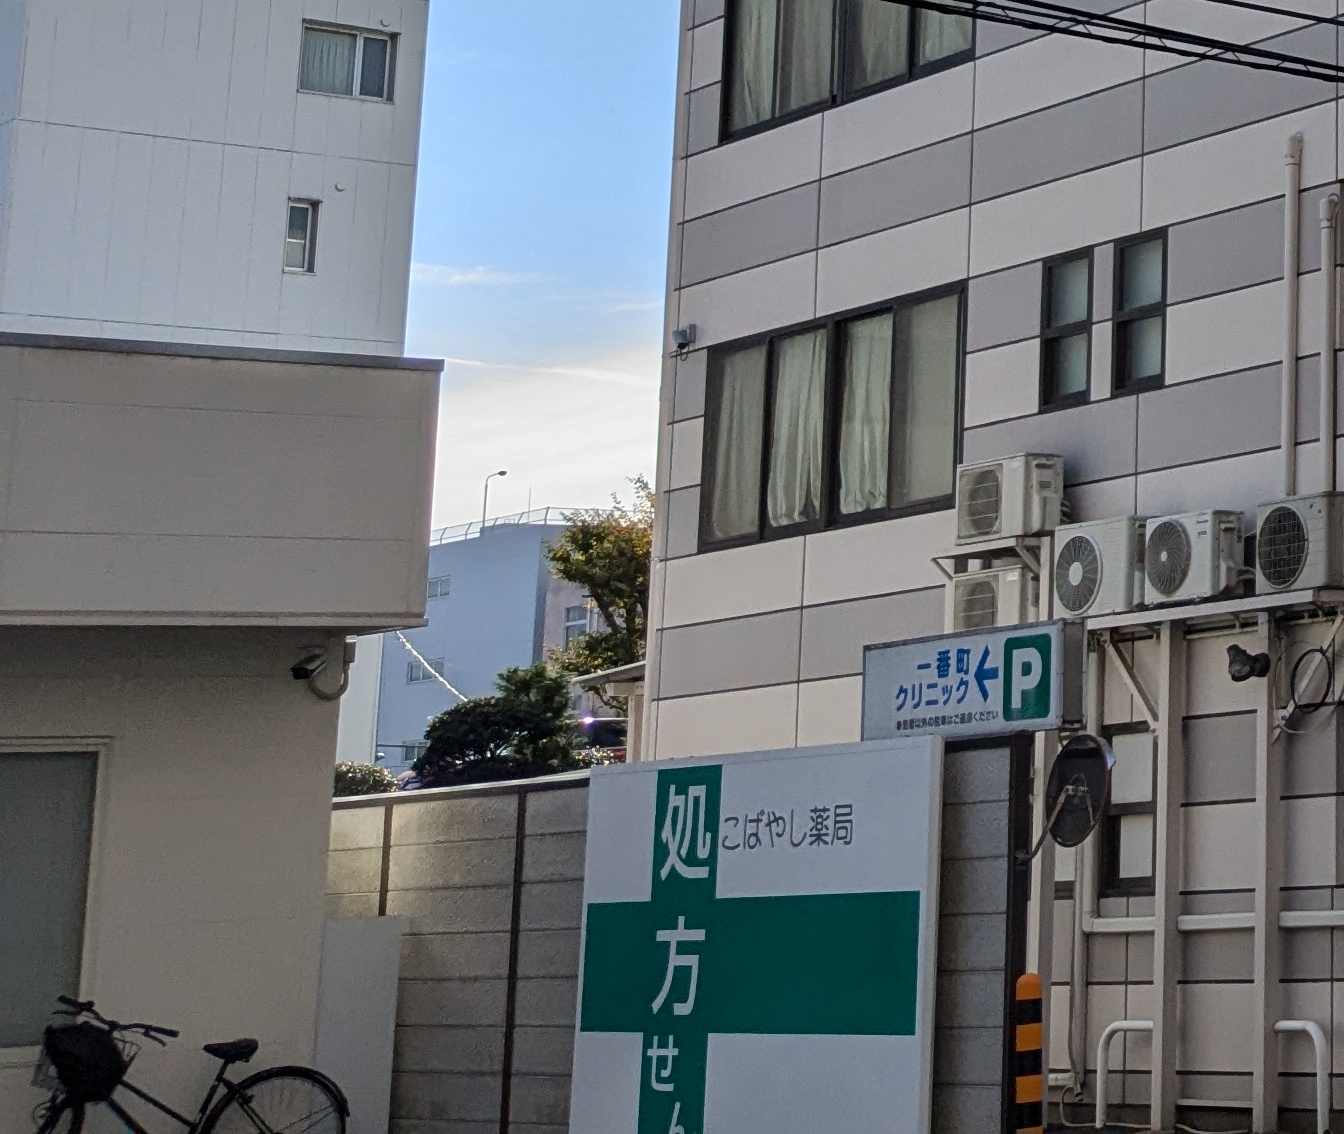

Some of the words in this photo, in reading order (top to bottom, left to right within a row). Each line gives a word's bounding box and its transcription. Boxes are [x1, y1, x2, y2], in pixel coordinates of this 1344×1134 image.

[917, 648, 971, 679] 一番町
[1011, 647, 1043, 709] P
[896, 677, 970, 712] クリニック
[721, 804, 855, 851] こばやし薬局
